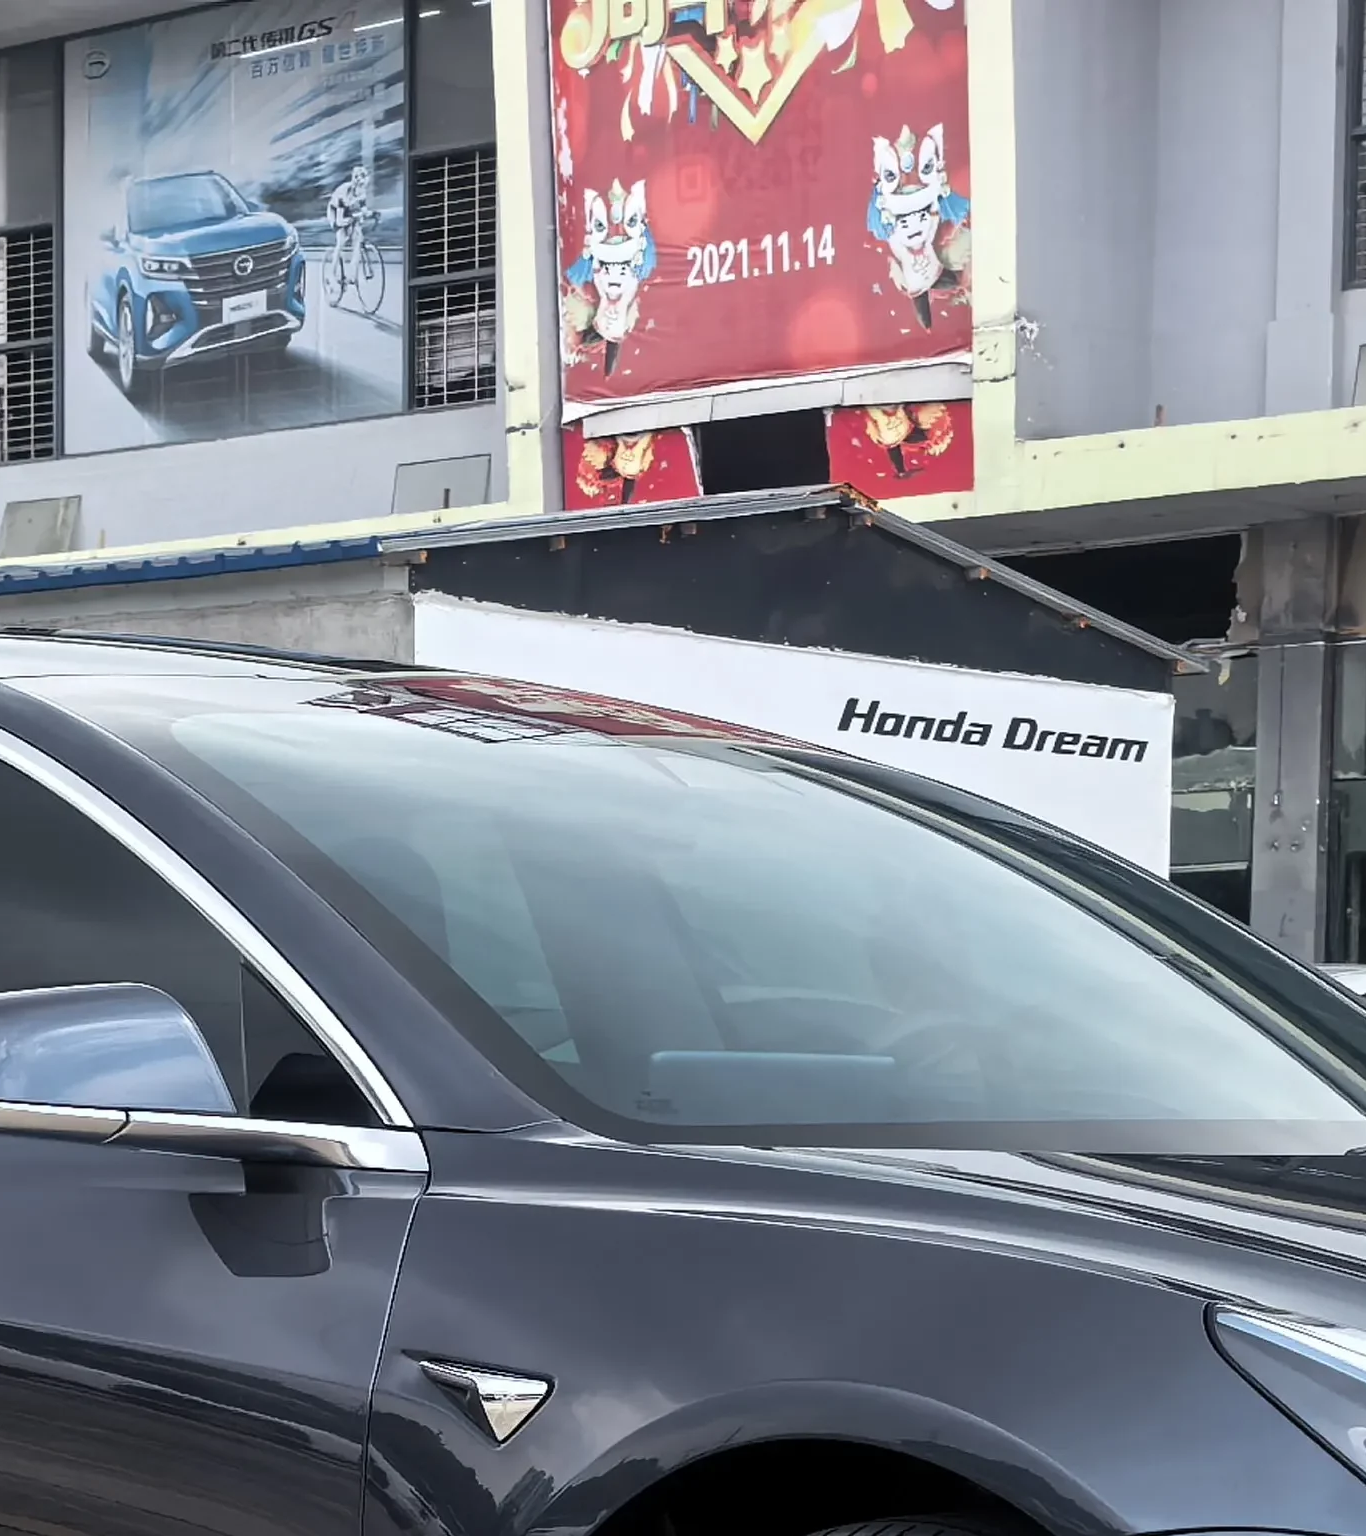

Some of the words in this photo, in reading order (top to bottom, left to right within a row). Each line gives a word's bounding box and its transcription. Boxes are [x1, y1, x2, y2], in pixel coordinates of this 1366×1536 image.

[686, 224, 835, 288] 2021.11.14
[837, 697, 993, 747] Honda
[1003, 717, 1149, 762] Dream
